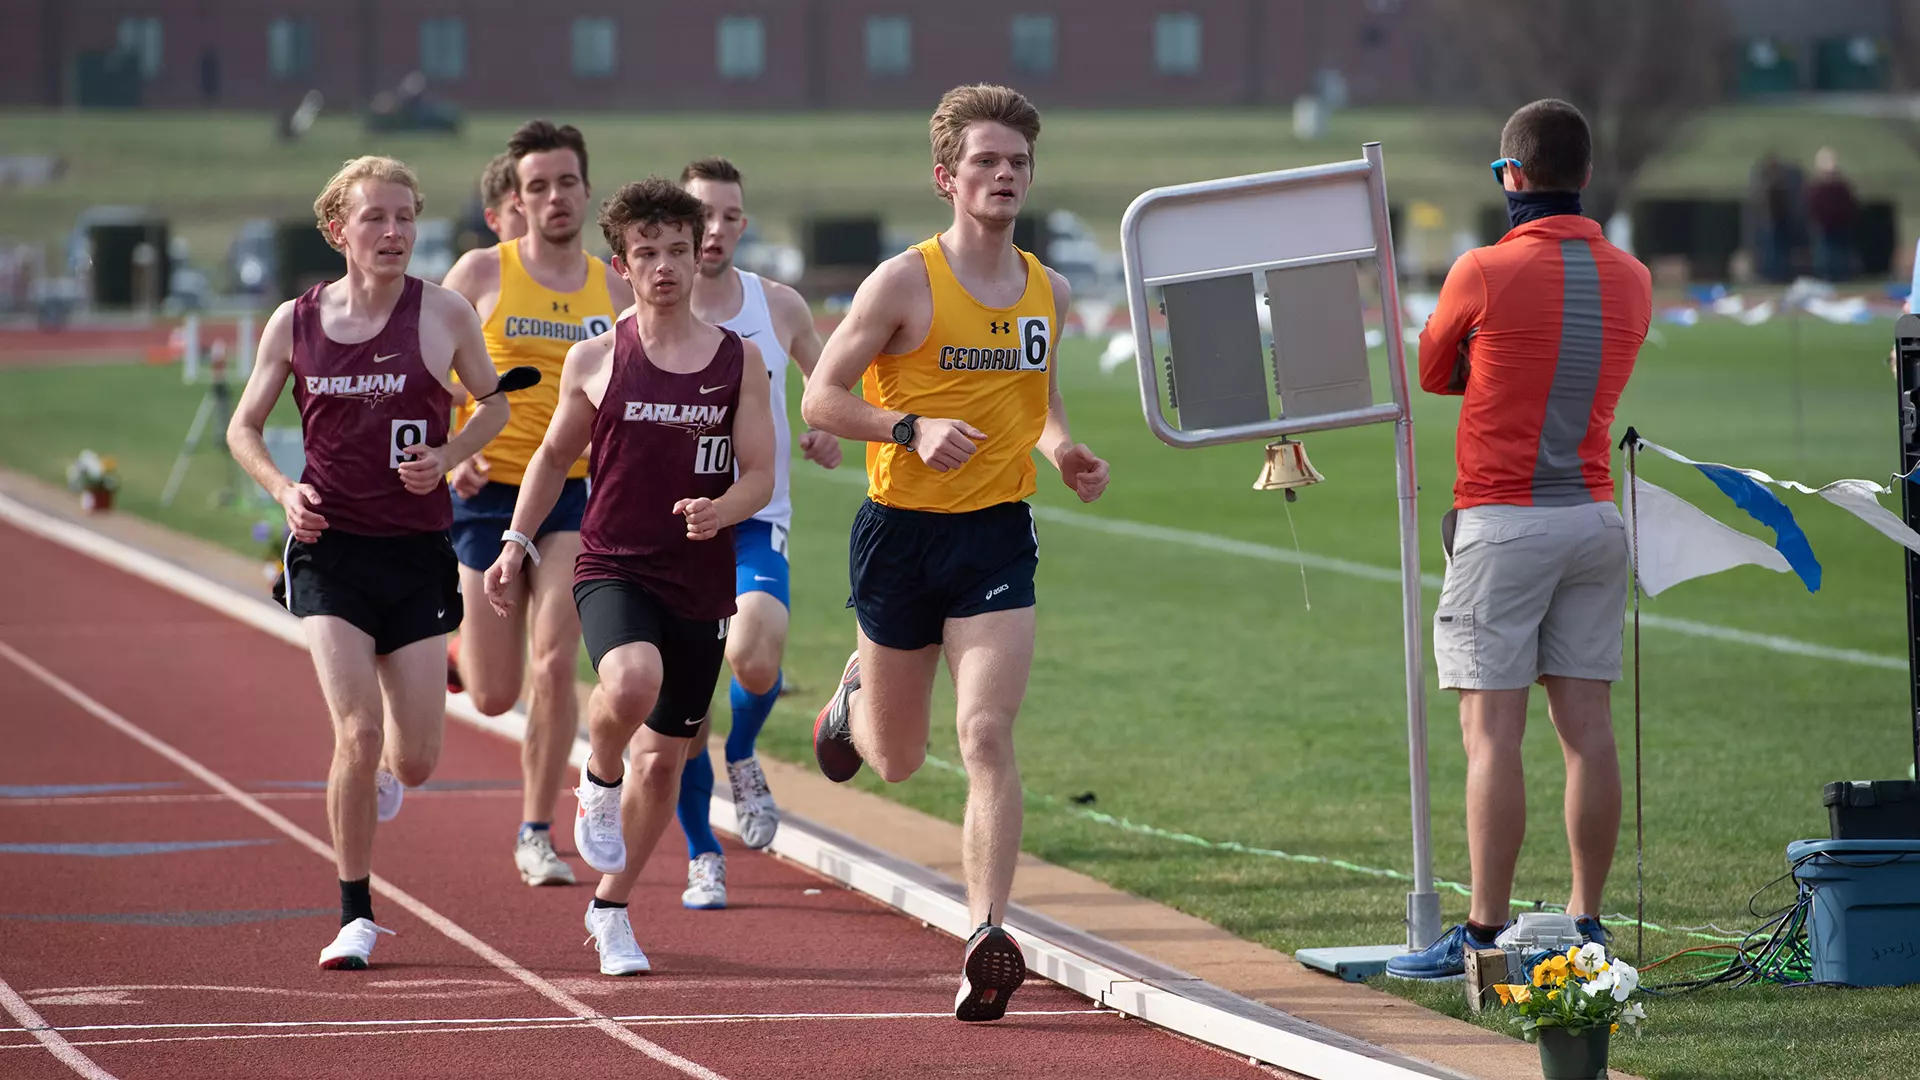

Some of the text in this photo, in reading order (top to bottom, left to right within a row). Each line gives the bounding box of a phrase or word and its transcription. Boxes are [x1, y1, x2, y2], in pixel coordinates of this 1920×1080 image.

[1024, 319, 1047, 365] 6
[939, 346, 1048, 372] CEDARVI
[304, 373, 407, 395] EARLHAM
[623, 401, 728, 424] EARLHAM
[395, 424, 421, 465] 9
[701, 438, 729, 472] 10
